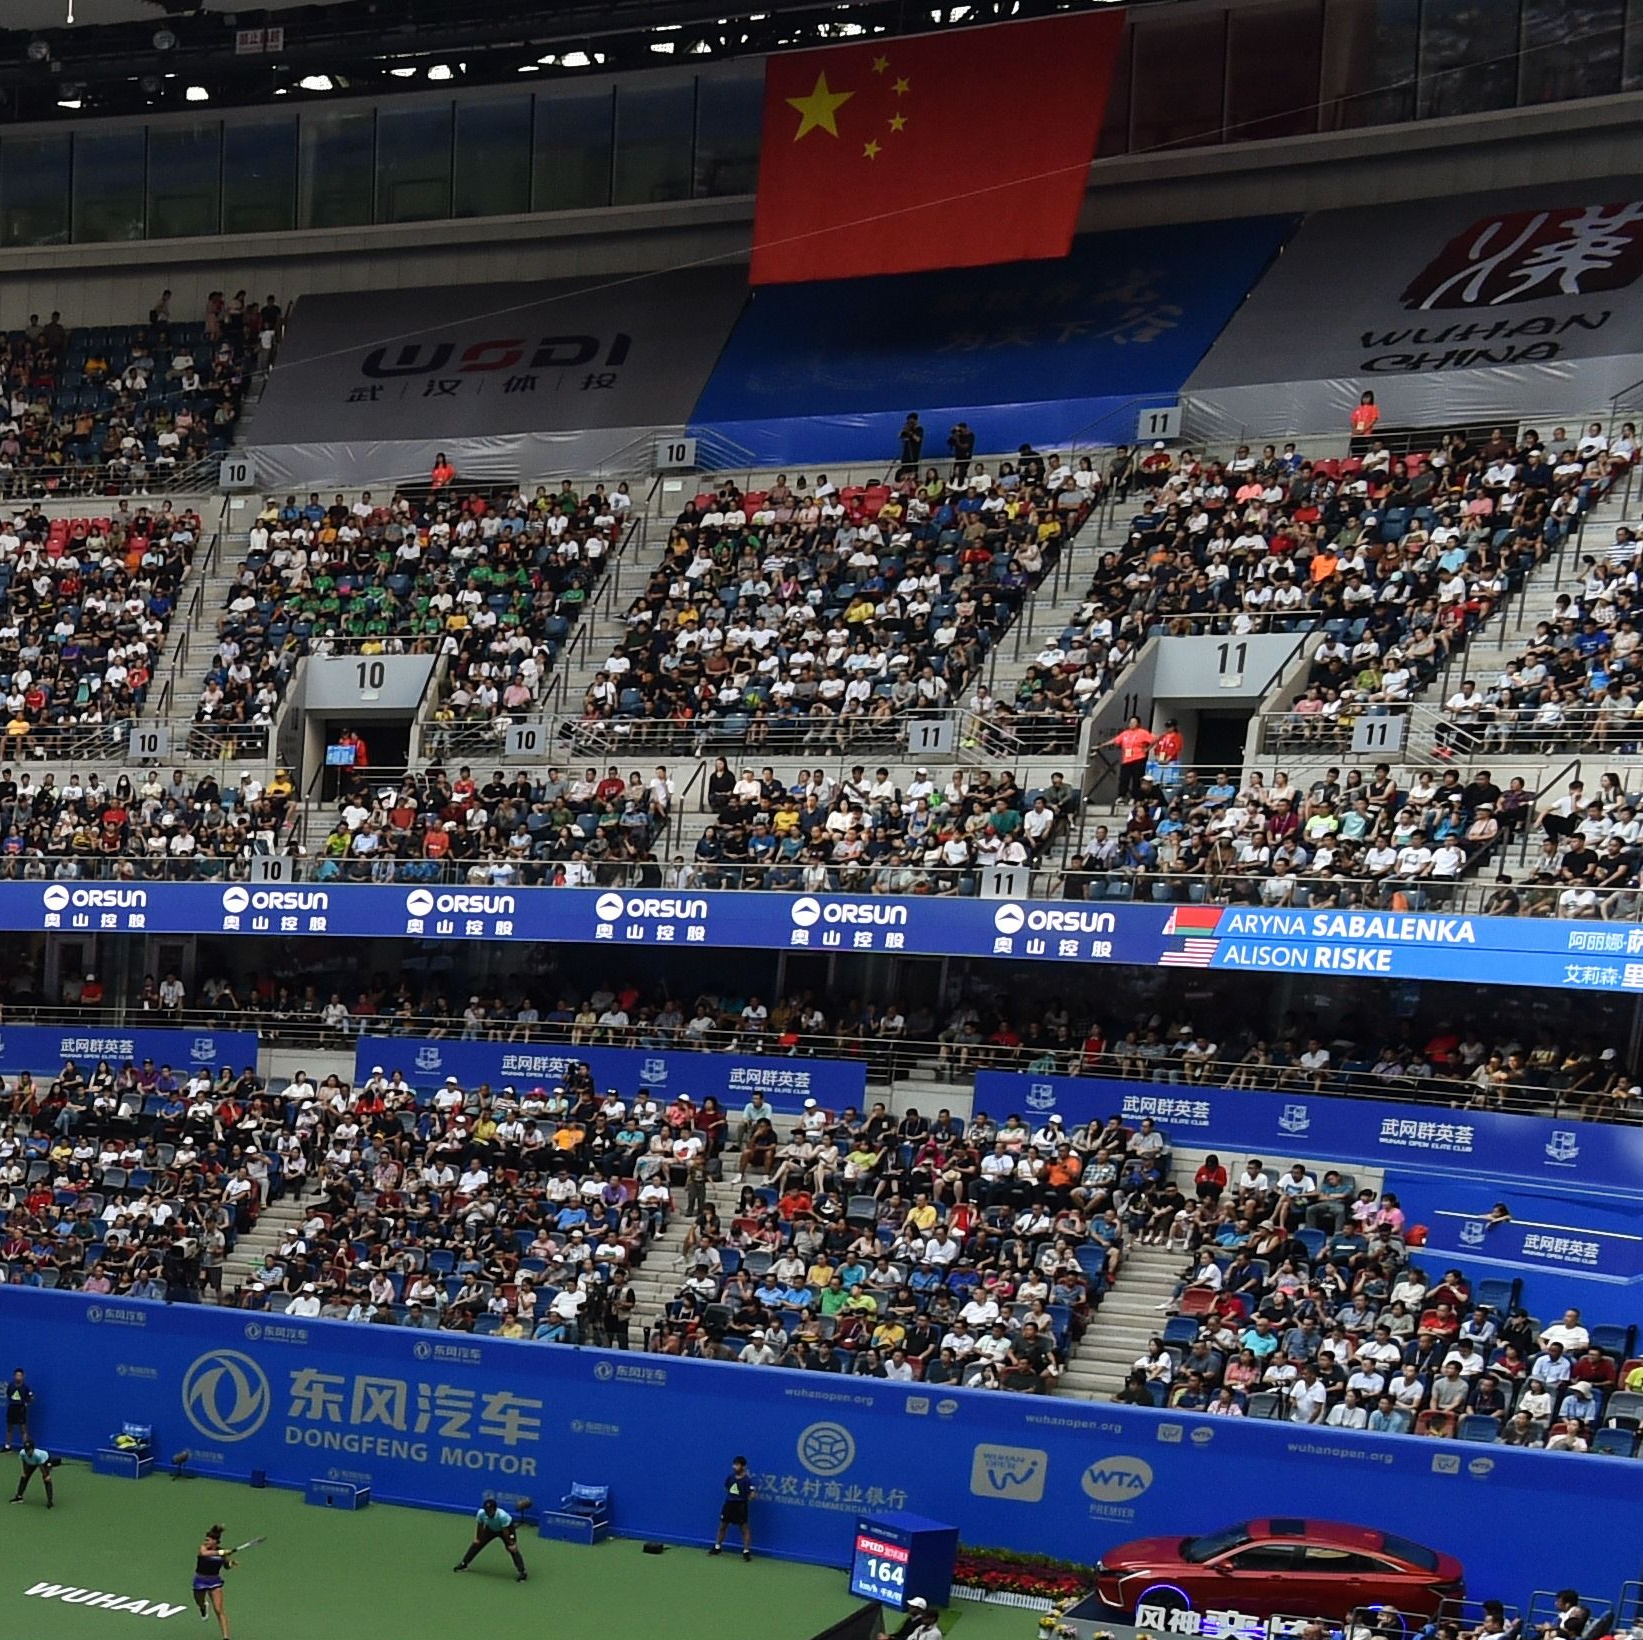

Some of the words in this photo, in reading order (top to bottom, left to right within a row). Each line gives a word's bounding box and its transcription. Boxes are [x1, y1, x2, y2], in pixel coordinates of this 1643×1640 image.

[1361, 311, 1611, 348] WUHAN
[1361, 342, 1564, 372] CHINA
[1217, 642, 1248, 674] 11
[356, 661, 385, 689] 10
[139, 734, 158, 753] 10
[1366, 723, 1388, 746] 11
[261, 860, 282, 881] 10
[993, 872, 1014, 895] 11
[436, 894, 515, 914] ORSUN
[406, 918, 514, 936] 奥山控股
[1027, 910, 1116, 933] ORSUN
[1227, 914, 1306, 935] ARYNA
[1312, 912, 1476, 944] SABALENKA
[992, 936, 1113, 958] 奥山控股
[1223, 945, 1309, 967] ALISON
[1314, 946, 1393, 972] RISKE
[729, 1067, 811, 1089] 武网群英荟
[1122, 1096, 1210, 1118] 武网群英荟
[1380, 1119, 1474, 1144] 武网群英荟
[1525, 1235, 1600, 1257] 武网群英荟
[286, 1367, 542, 1446] 东风汽车
[784, 1387, 875, 1407] wuhanopen.org
[285, 1425, 429, 1465] DONGFENG
[440, 1445, 537, 1477] MOTOR
[1286, 1440, 1394, 1466] wuhanopen.org
[751, 1472, 908, 1510] 汉农村商业银行
[1086, 1467, 1148, 1492] WTA
[860, 1538, 884, 1553] SPEED
[867, 1558, 904, 1585] 164
[25, 1581, 188, 1620] WUHAN
